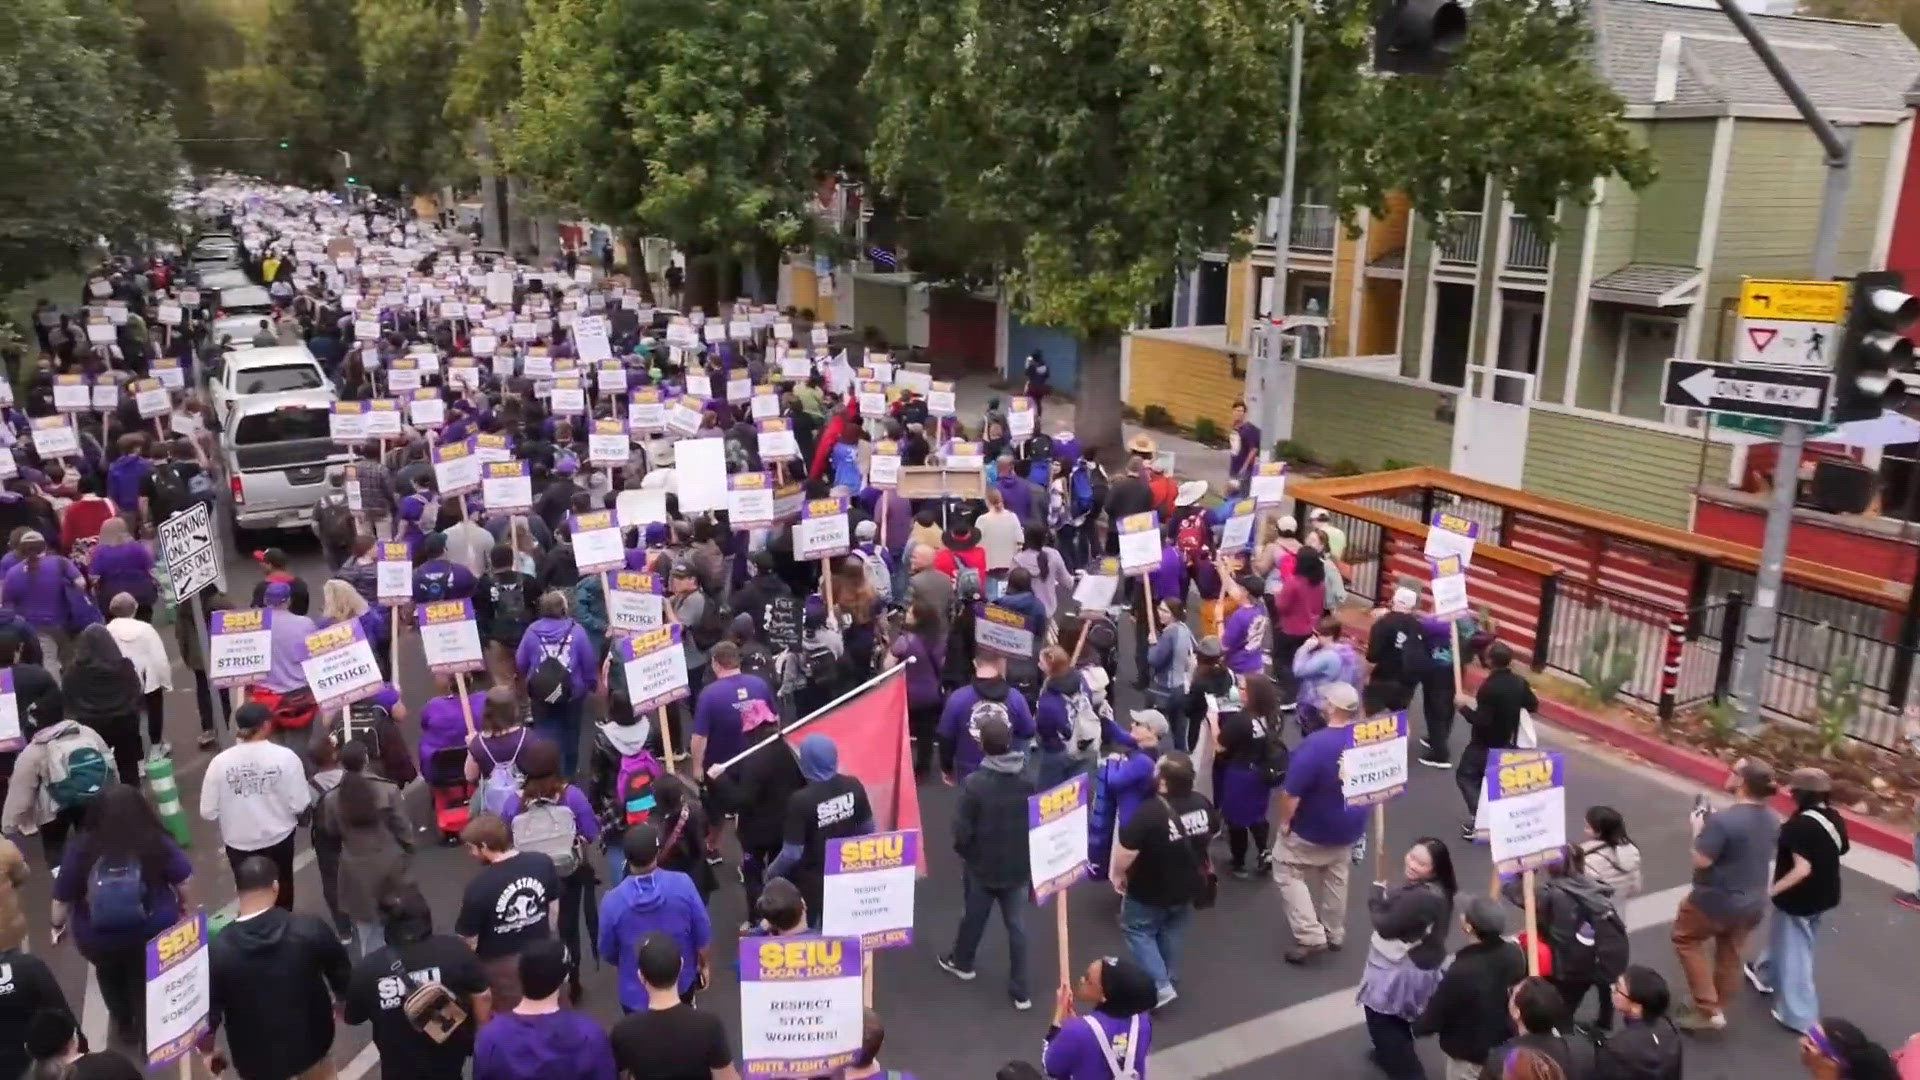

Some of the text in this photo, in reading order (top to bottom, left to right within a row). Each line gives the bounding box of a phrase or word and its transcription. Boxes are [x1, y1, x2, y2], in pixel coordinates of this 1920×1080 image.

[1717, 380, 1804, 400] ONE WAY
[163, 509, 207, 544] PARKING
[167, 539, 192, 562] ONLY
[172, 549, 212, 583] BIKES ONLY
[217, 654, 264, 669] STRIKE!
[317, 663, 372, 690] STRIKE!
[1353, 716, 1398, 739] SEIU
[1350, 764, 1403, 787] STRIKE!
[1499, 760, 1553, 790] SEIU
[816, 791, 855, 820] SEIU
[840, 834, 903, 863] SEIU
[841, 857, 903, 871] LOCAL 1000
[854, 884, 887, 896] RESPECT
[157, 917, 200, 960] SEIU
[758, 940, 842, 969] SEIU
[759, 965, 842, 978] LOCAL 1000
[770, 999, 833, 1011] RESPECT
[779, 1015, 824, 1026] STATE
[765, 1031, 838, 1042] WORKERS!
